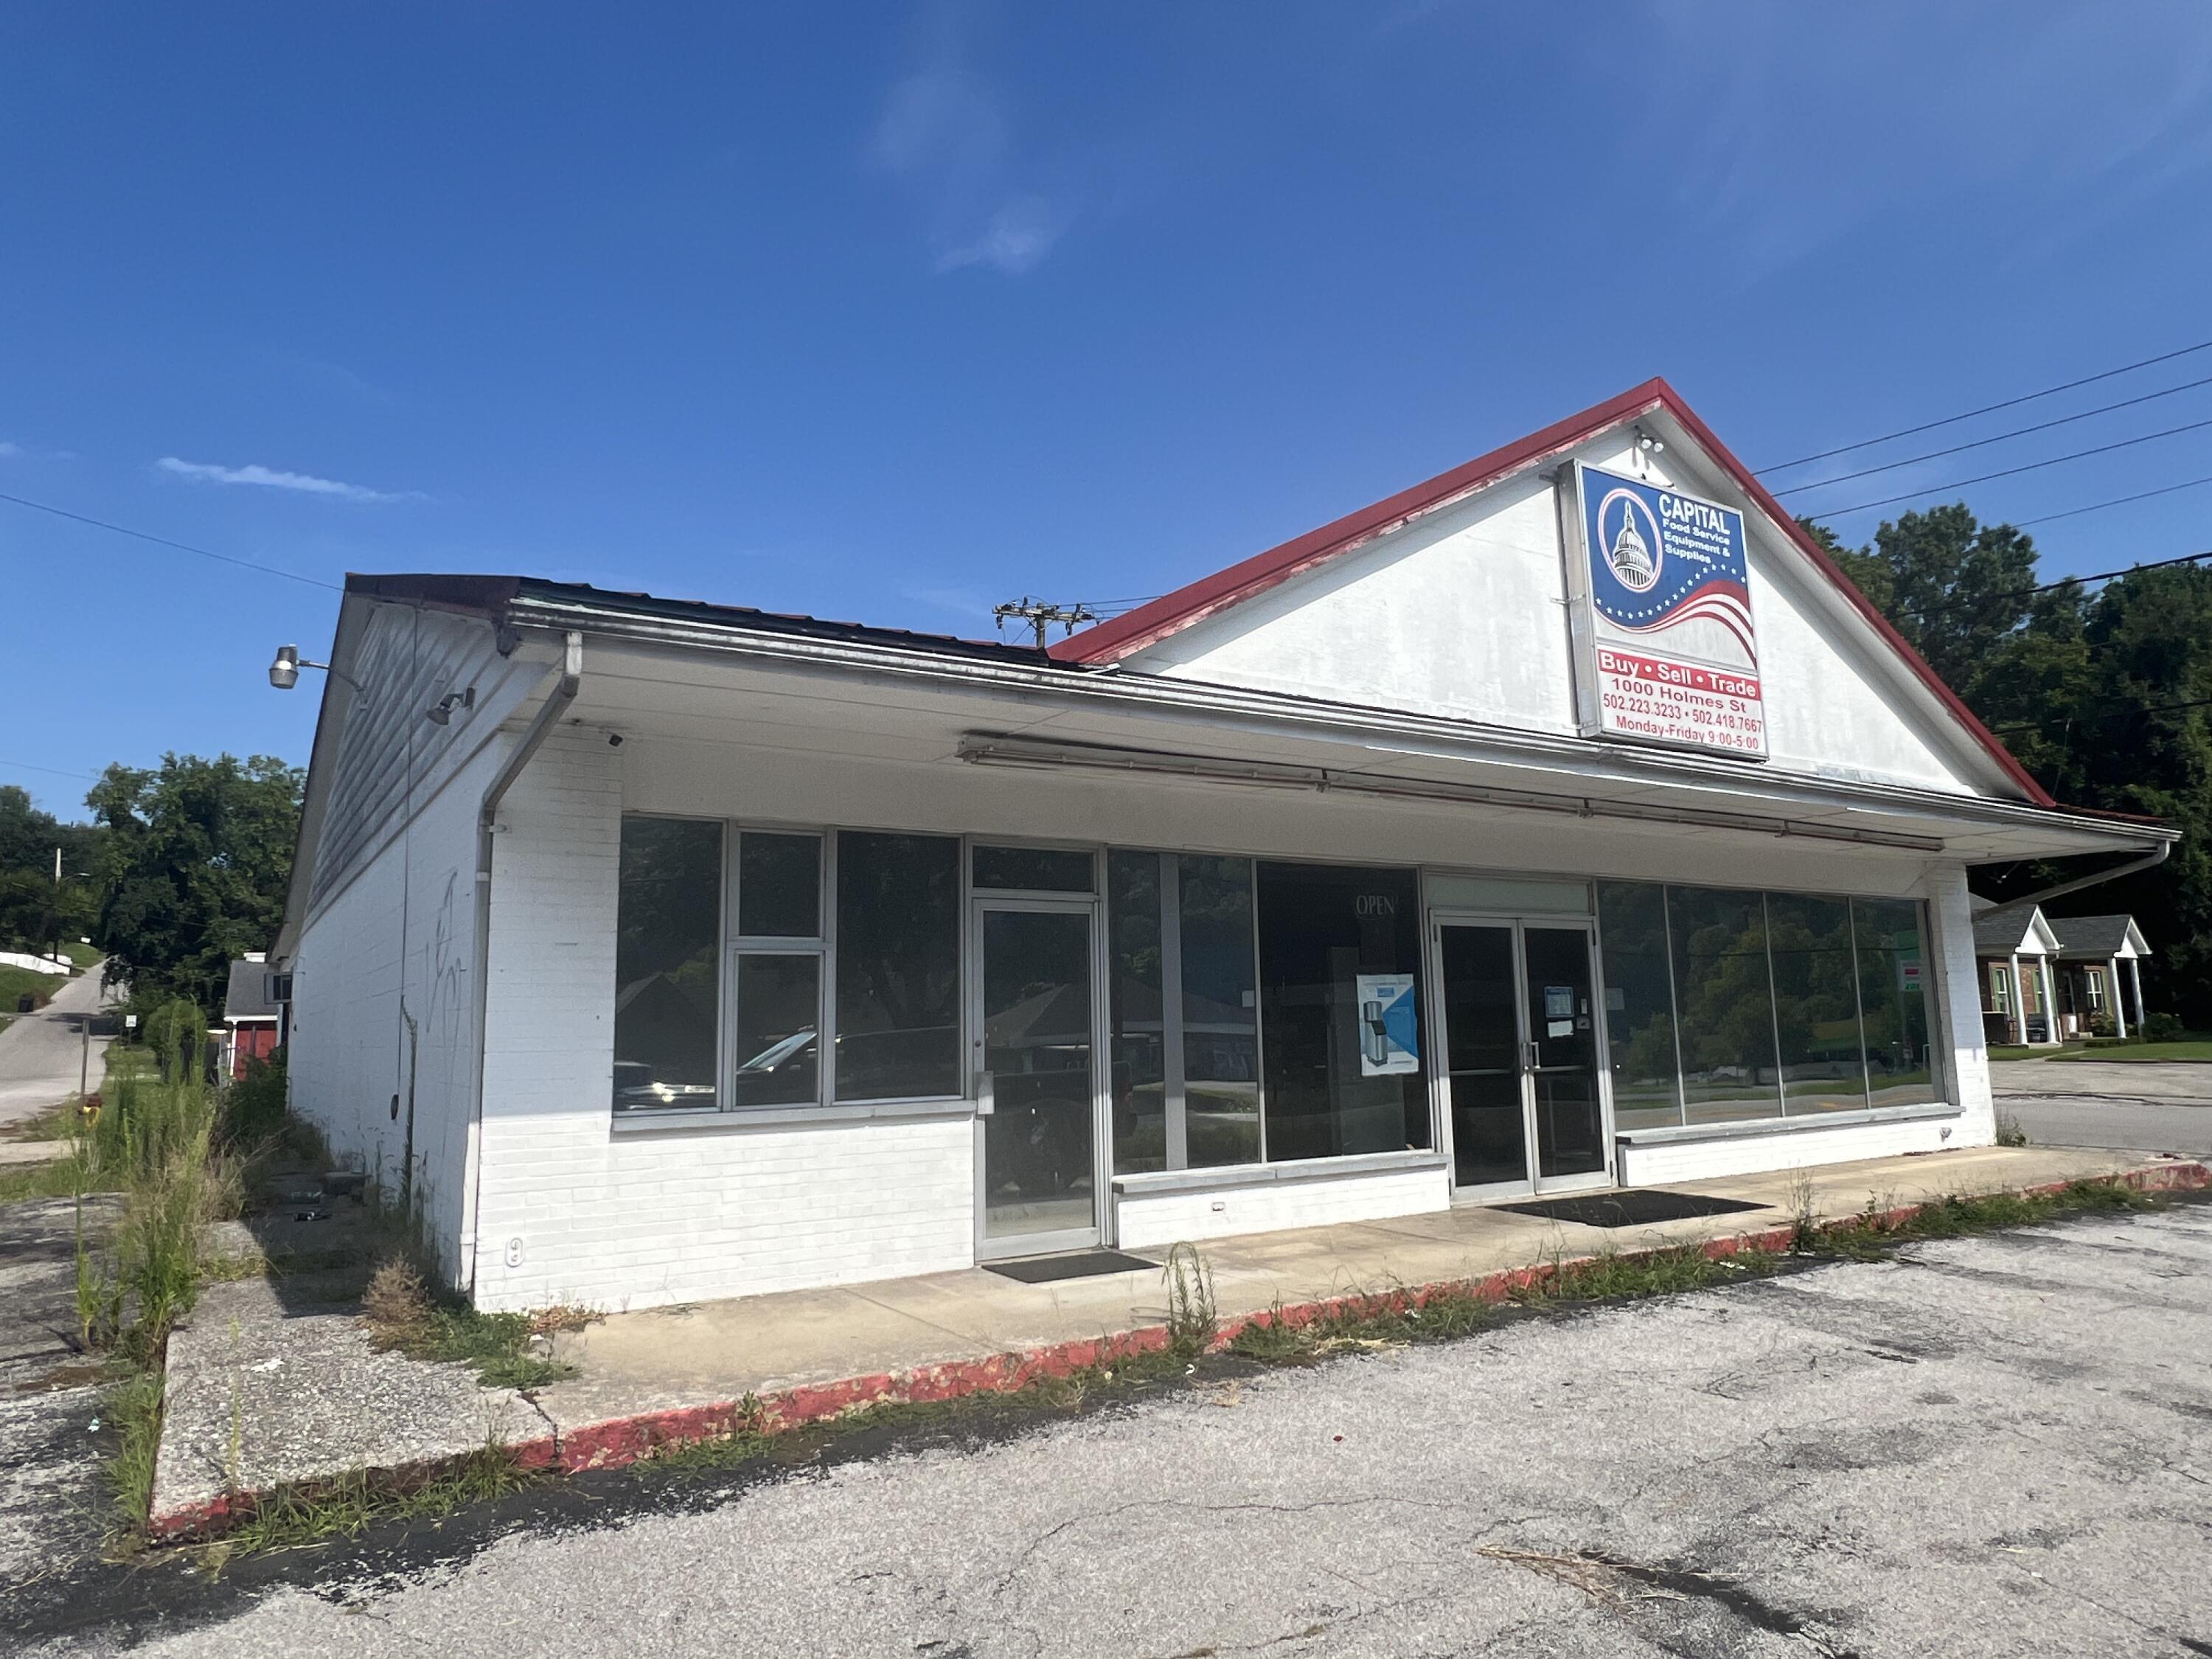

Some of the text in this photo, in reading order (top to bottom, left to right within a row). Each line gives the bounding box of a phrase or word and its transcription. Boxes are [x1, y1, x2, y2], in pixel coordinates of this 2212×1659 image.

[1658, 493, 1731, 535] CAPITAL
[1662, 518, 1731, 545] Food Service
[1663, 531, 1731, 557] Equipment &
[1664, 543, 1711, 564] Supplies
[1600, 652, 1756, 697] Buy Sell Trade
[1612, 678, 1747, 714] 1000 Holmes St
[1603, 693, 1762, 733] 502.223.3233 502.418.7667
[1615, 715, 1705, 743] Monday-Friday
[1356, 894, 1395, 915] OPEN
